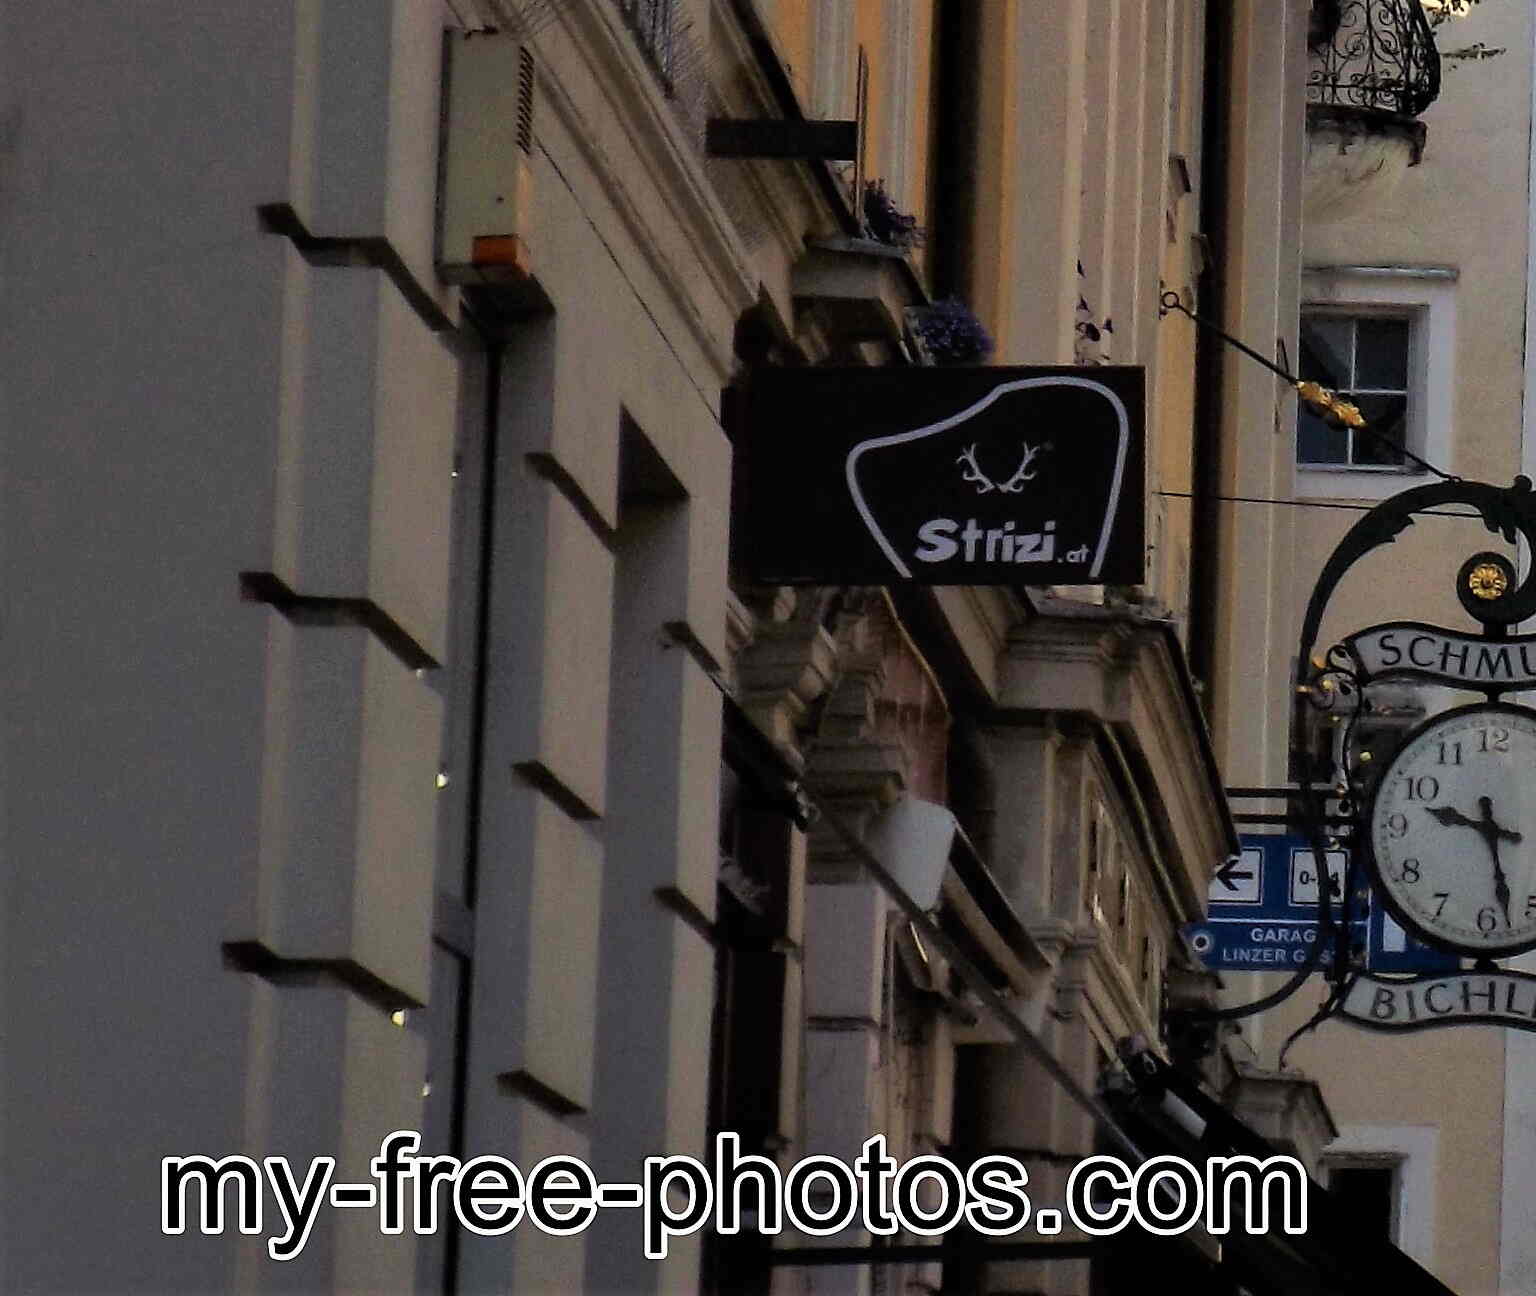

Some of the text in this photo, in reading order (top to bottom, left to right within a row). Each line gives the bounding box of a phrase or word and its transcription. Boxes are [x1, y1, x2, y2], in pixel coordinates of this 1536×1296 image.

[1475, 728, 1510, 753] 12
[1437, 741, 1463, 767] 11
[1404, 775, 1440, 803] 10
[1388, 813, 1408, 839] 9
[1401, 858, 1421, 884] 8
[1433, 892, 1449, 918] 7
[1476, 906, 1497, 934] 6
[1250, 927, 1318, 944] GARAG
[1222, 947, 1288, 962] LINZER
